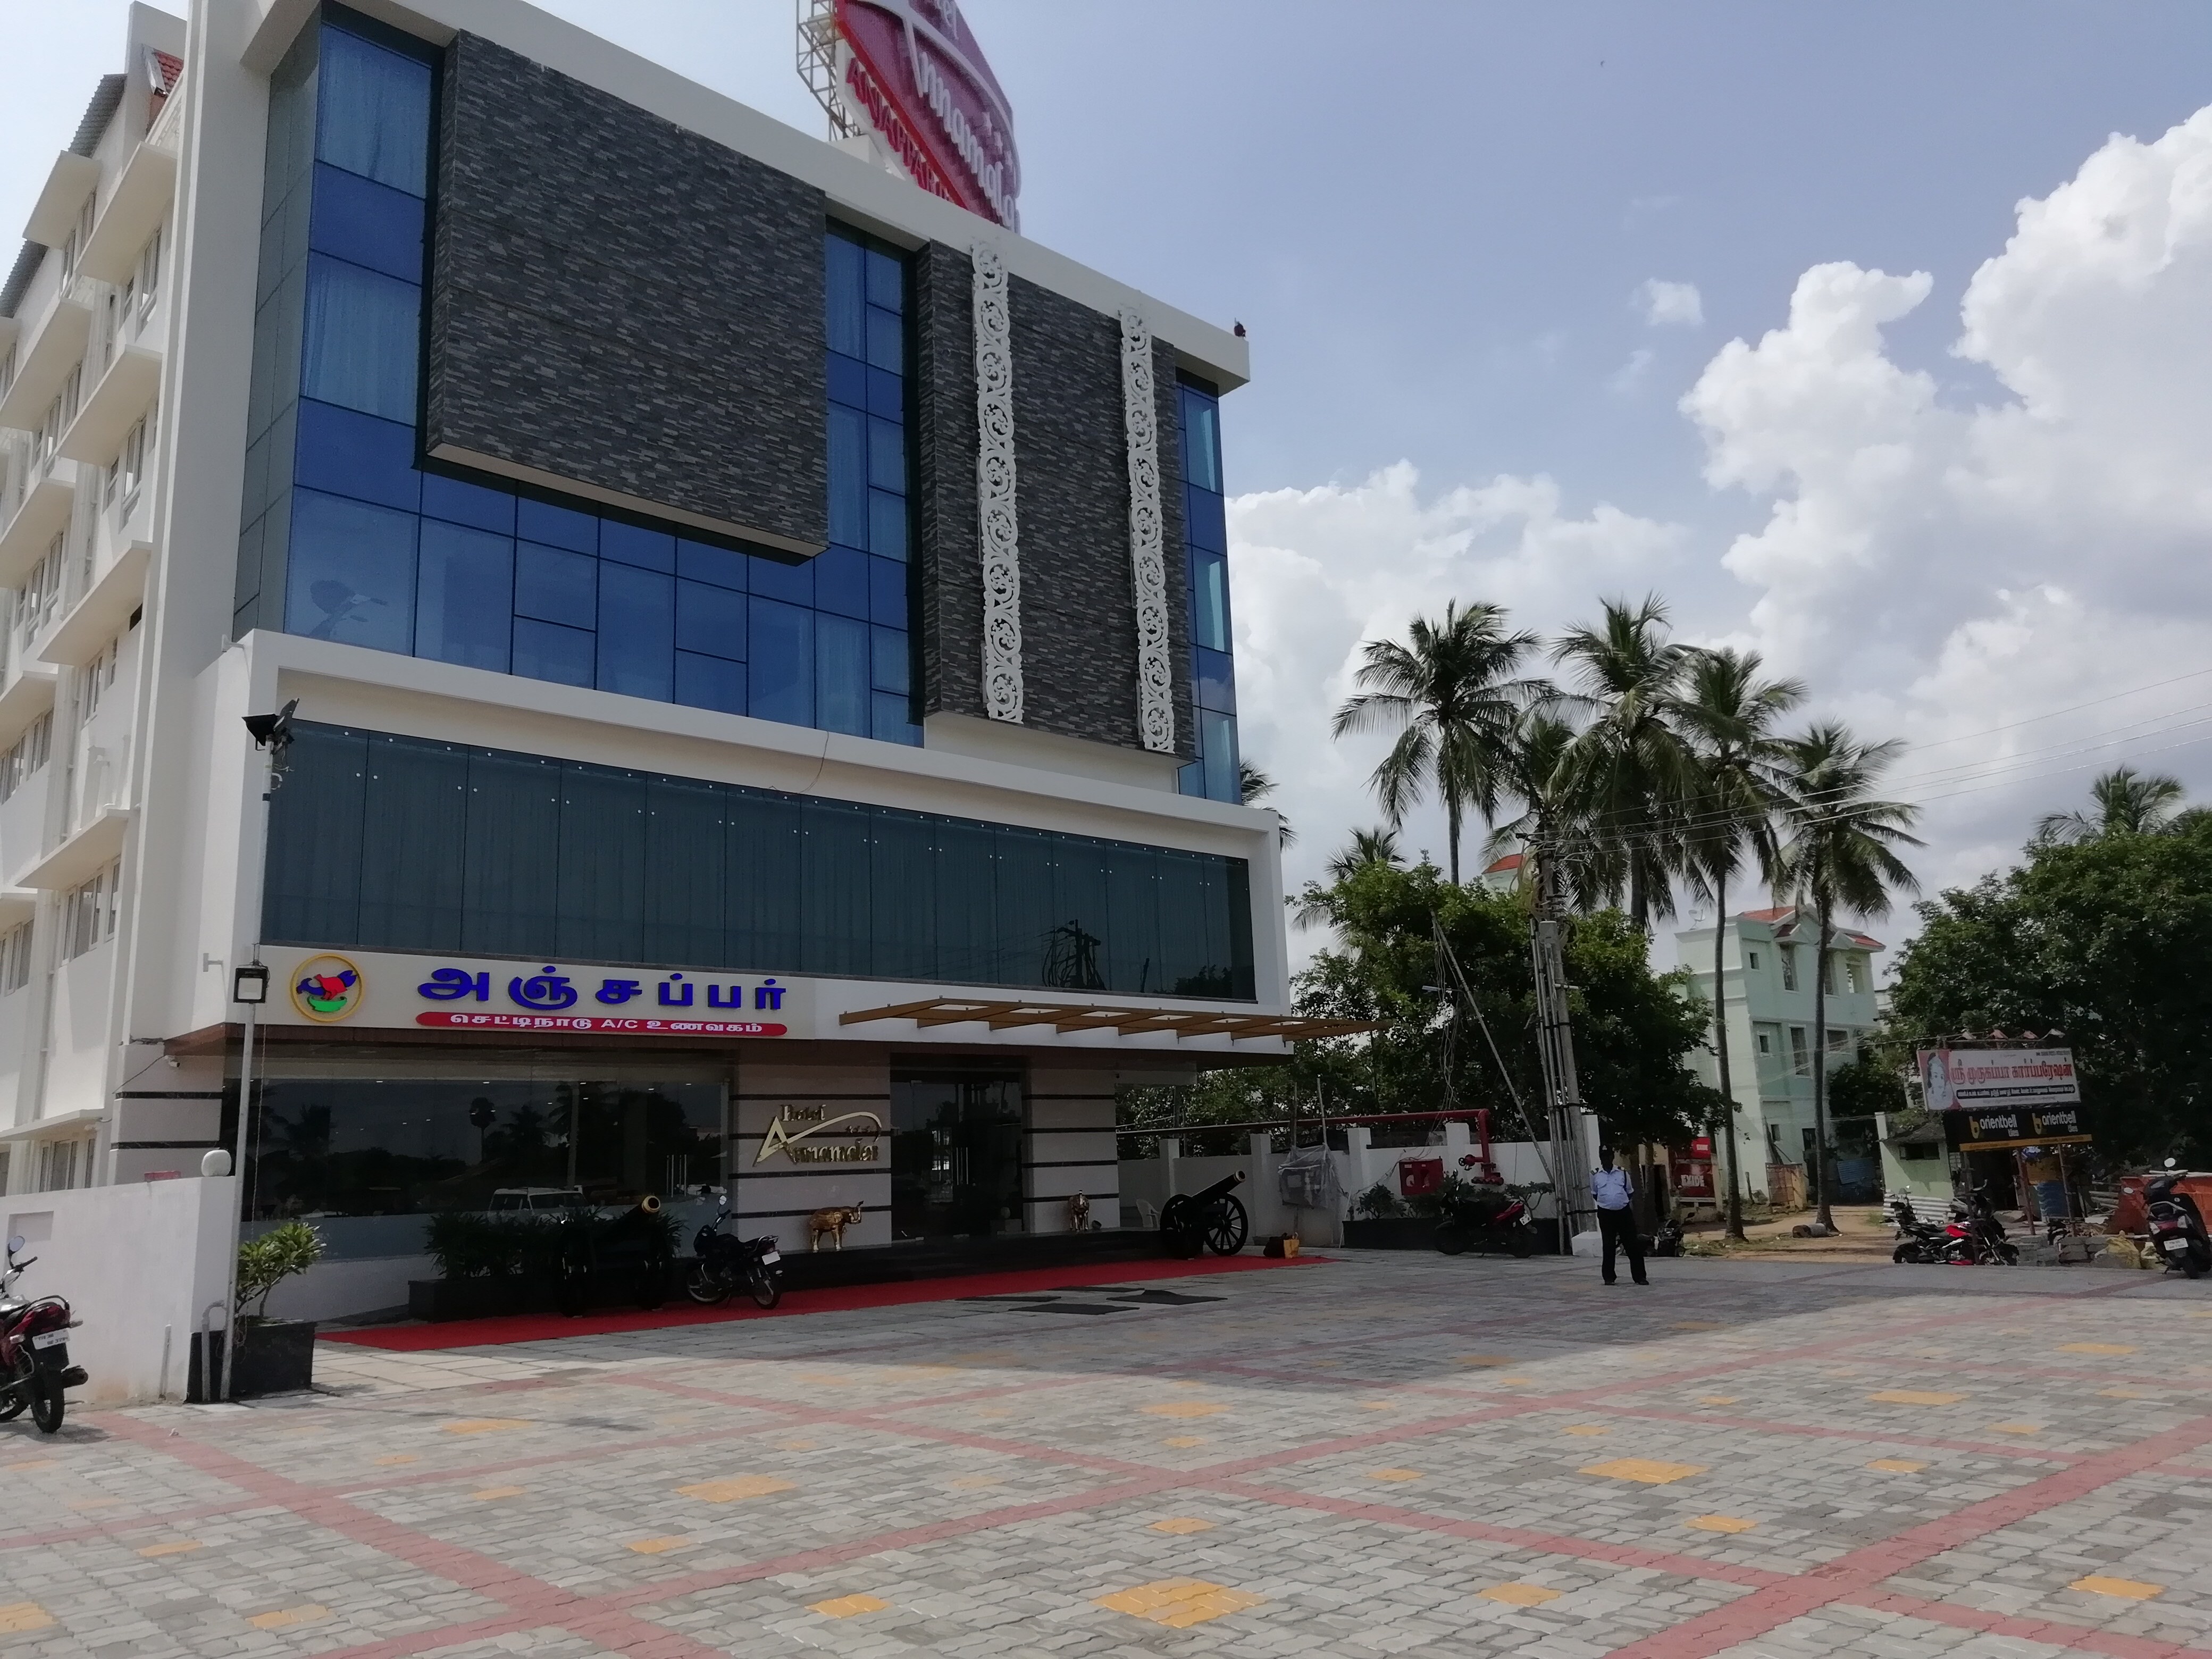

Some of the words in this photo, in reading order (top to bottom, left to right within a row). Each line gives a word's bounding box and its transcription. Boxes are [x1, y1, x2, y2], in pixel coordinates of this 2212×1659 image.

[417, 966, 786, 1010] அஞ்சப்பர்
[450, 1014, 592, 1029] செட்டிநாடு
[601, 1019, 638, 1029] A/C
[647, 1020, 763, 1032] உணவகம்
[1980, 1114, 2018, 1130] orientbell
[2042, 1110, 2076, 1126] orientbell
[1681, 1174, 1705, 1187] EXIDE
